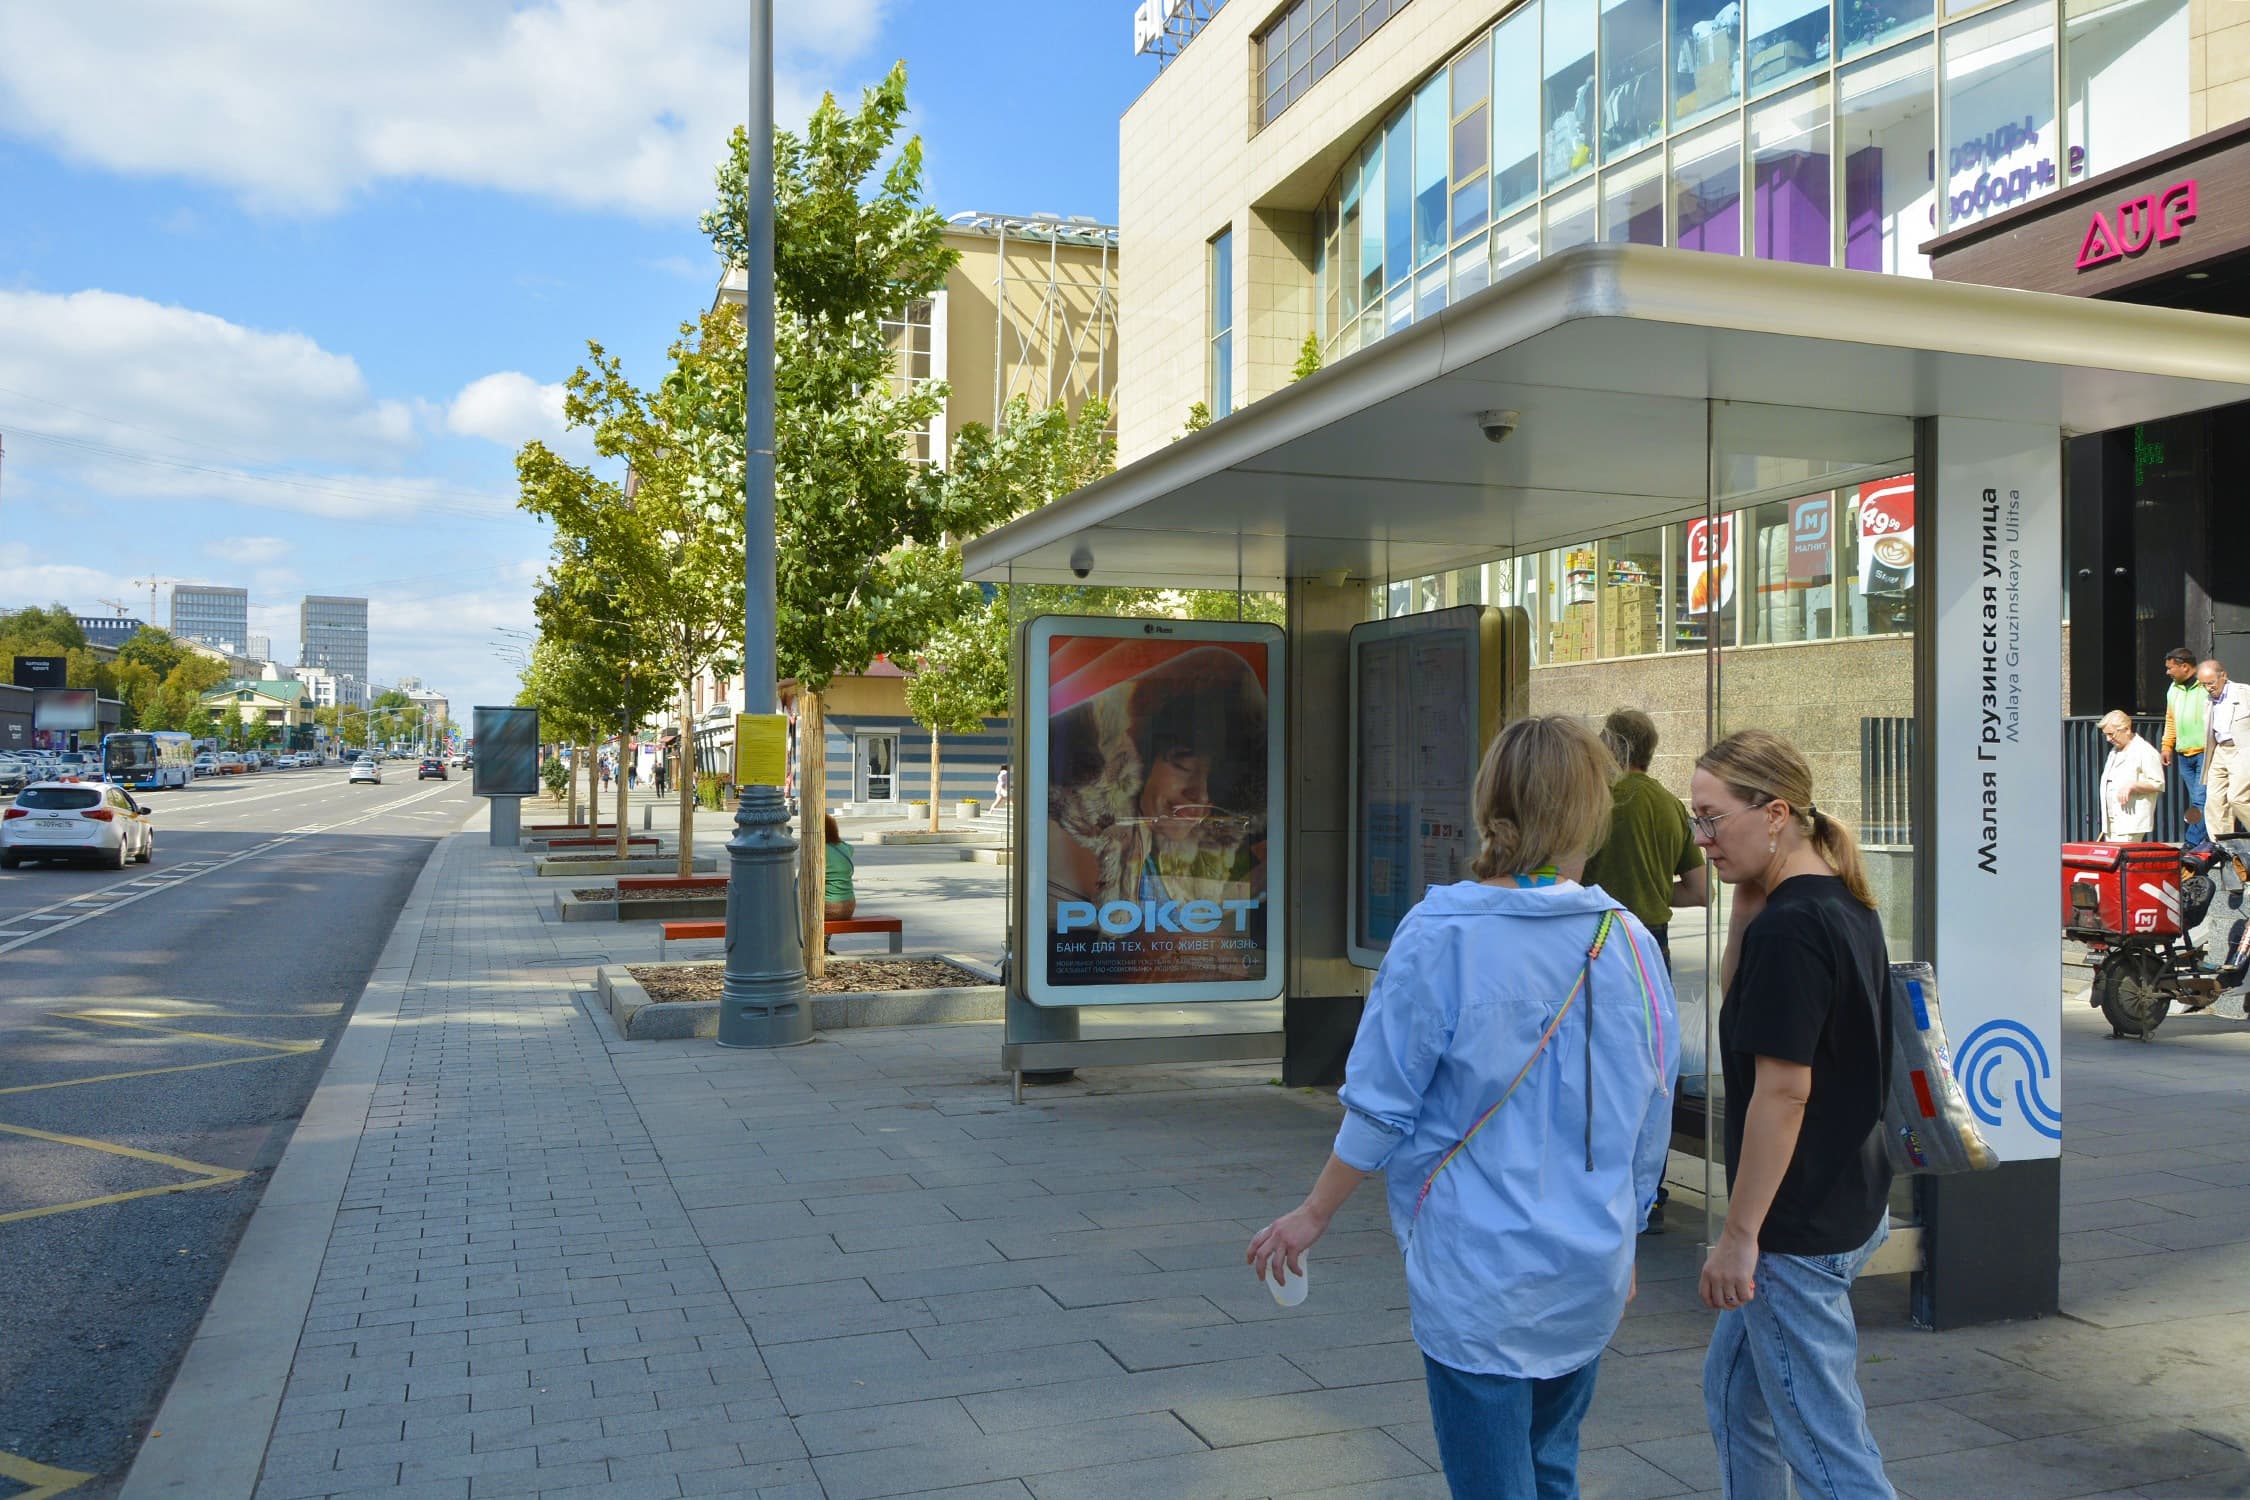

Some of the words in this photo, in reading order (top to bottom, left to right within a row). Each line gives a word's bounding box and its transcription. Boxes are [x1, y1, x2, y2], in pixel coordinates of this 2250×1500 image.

[2074, 179, 2198, 269] AUF
[1794, 542, 1827, 553] МАГНИТ
[1982, 487, 2001, 578] улица
[2005, 489, 2020, 542] Ulitsa
[2005, 549, 2022, 667] Gruzinskaya
[1977, 586, 2001, 761] Грузинская
[2005, 673, 2022, 743] Malaya
[1977, 772, 1998, 875] Малая
[1056, 941, 1087, 953] БАНК
[1091, 941, 1116, 954] ДЛЯ
[1121, 941, 1146, 953] ТЕХ,
[1151, 940, 1174, 951] КТО
[1177, 939, 1217, 951] ЖИВЕТ
[1220, 938, 1259, 950] ЖИЗНЬ
